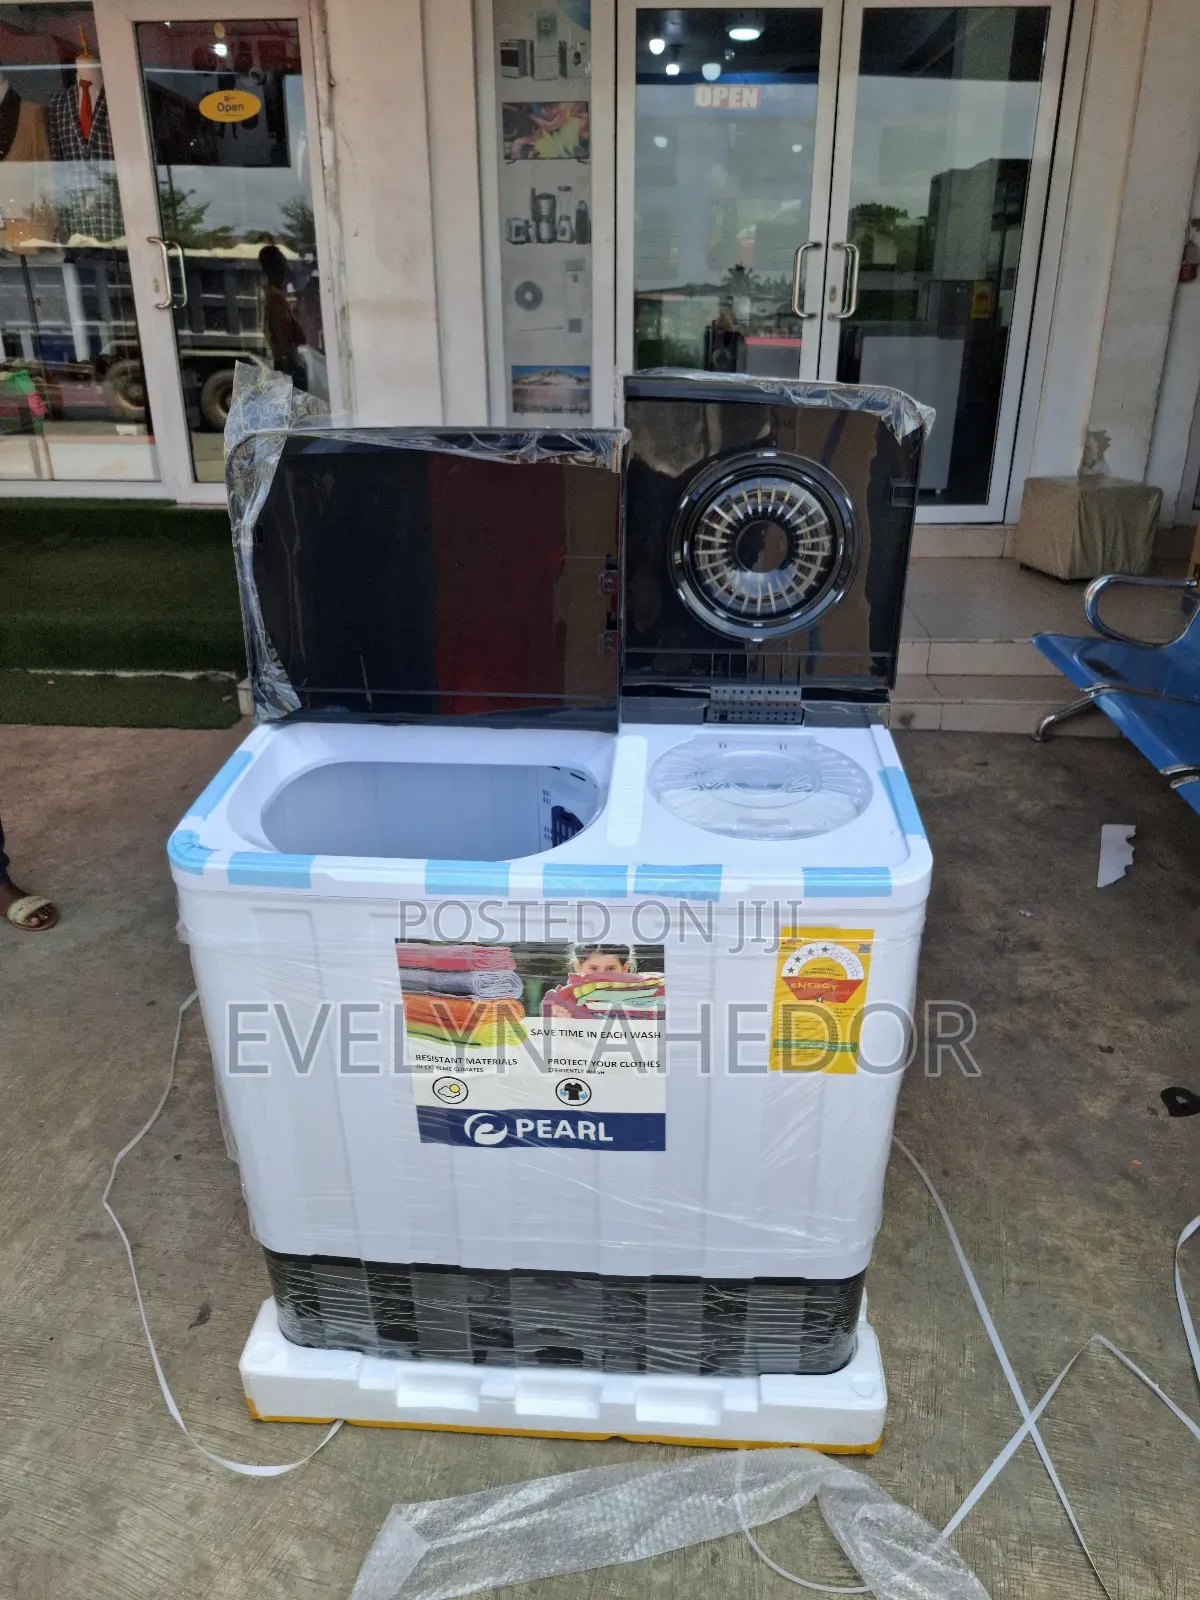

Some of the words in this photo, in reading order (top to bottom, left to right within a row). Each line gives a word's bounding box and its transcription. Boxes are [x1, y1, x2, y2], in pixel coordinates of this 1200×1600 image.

[694, 85, 759, 109] OPEN
[216, 102, 245, 114] Open
[790, 982, 839, 991] ENERGY
[530, 1028, 557, 1037] SAVE
[559, 1029, 584, 1038] TIME
[586, 1030, 597, 1039] IN
[600, 1031, 627, 1039] EACH
[631, 1031, 661, 1039] WASH
[415, 1054, 464, 1064] RESISTANT
[465, 1057, 518, 1066] MATERIALS
[547, 1058, 588, 1067] PROTECT
[590, 1060, 618, 1068] YOUR
[619, 1060, 661, 1068] CLOTHES
[515, 1118, 614, 1142] PEARL
